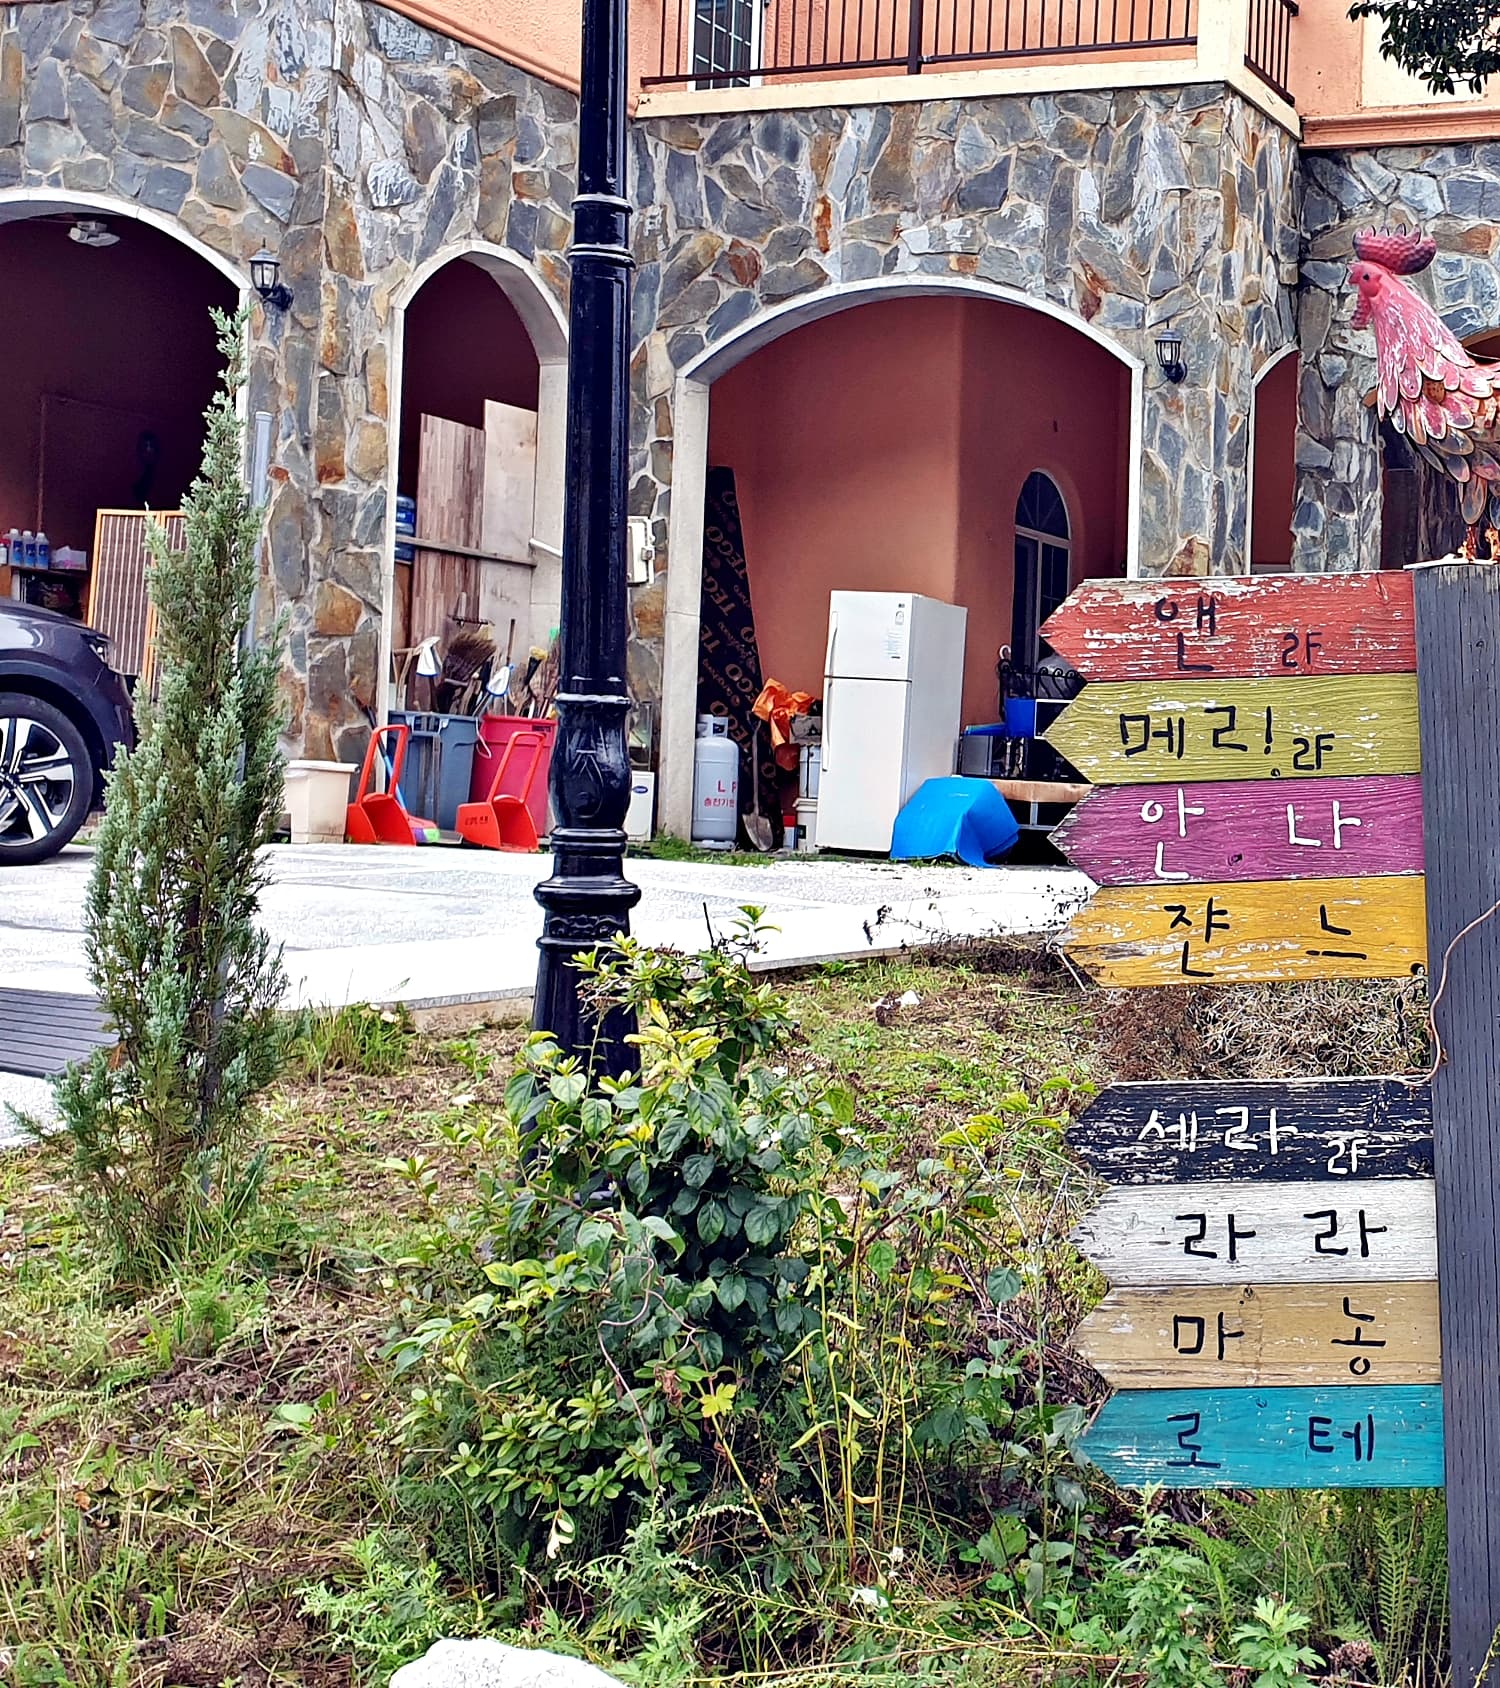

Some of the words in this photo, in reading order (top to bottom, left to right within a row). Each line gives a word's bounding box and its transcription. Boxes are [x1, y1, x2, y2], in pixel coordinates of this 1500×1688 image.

[703, 568, 736, 617] TEG
[1154, 596, 1216, 672] 앤
[1282, 632, 1322, 668] 2F
[1292, 733, 1335, 770] 2F
[1327, 1138, 1369, 1174] 2F
